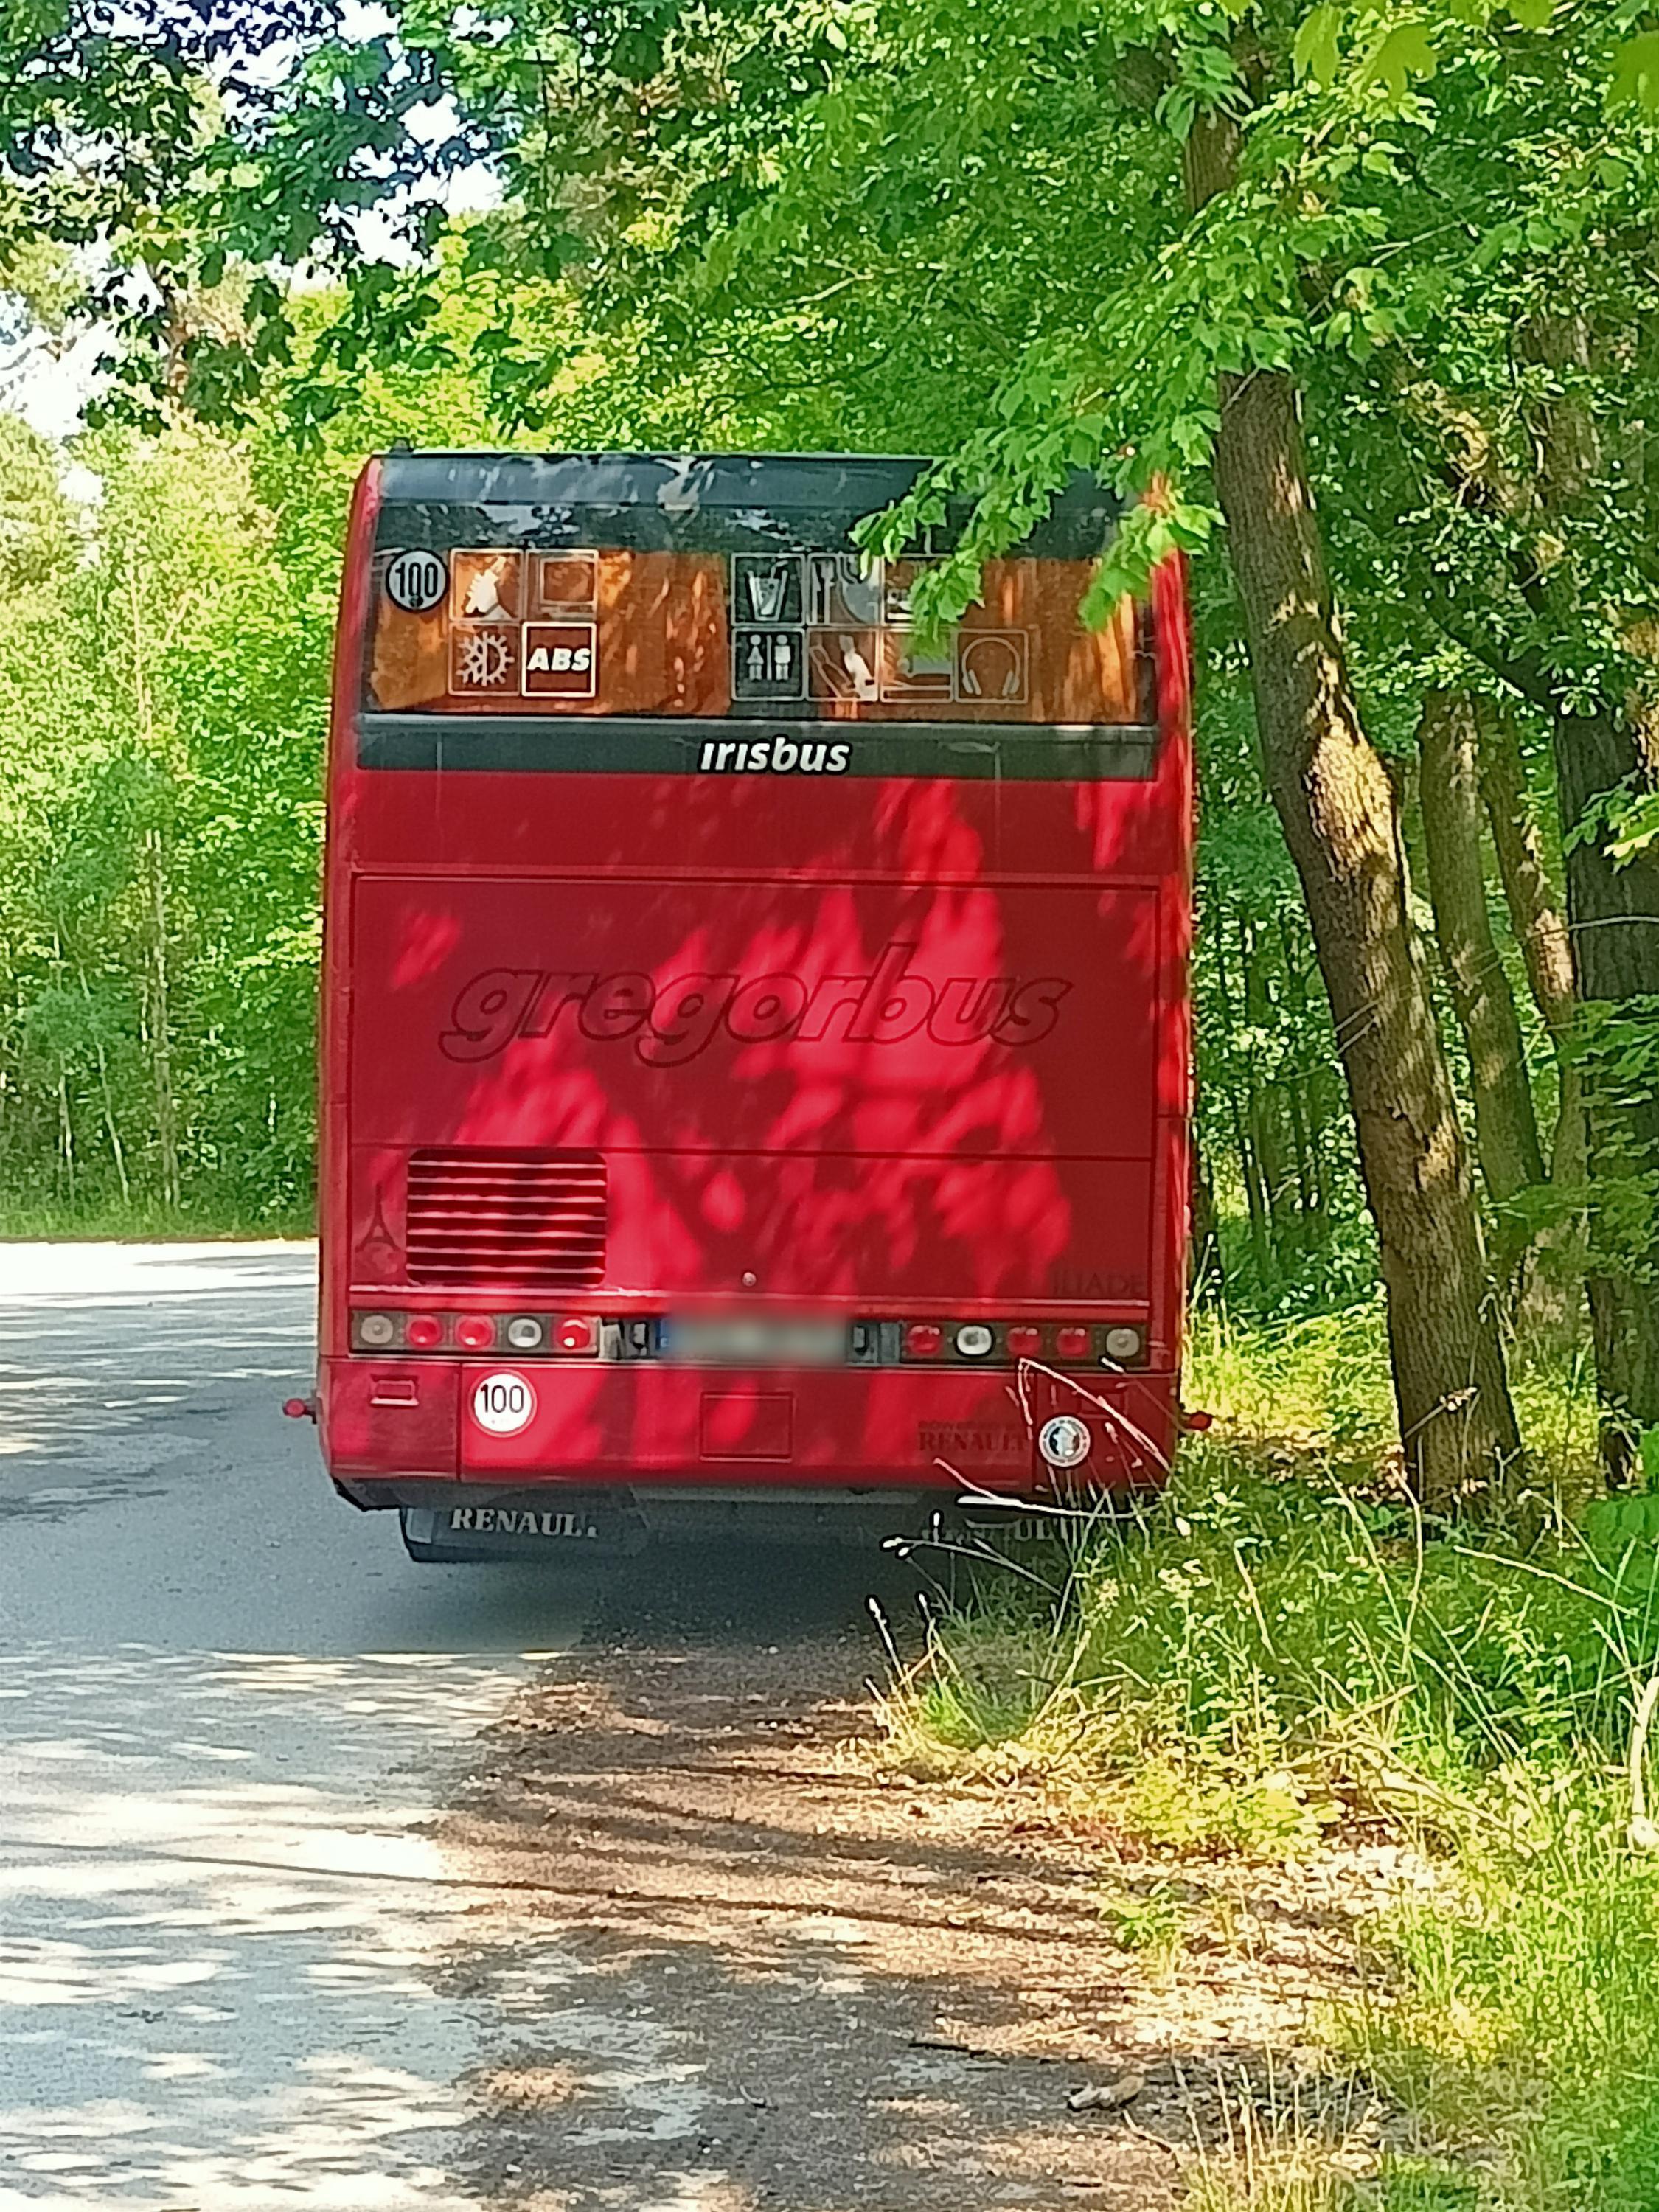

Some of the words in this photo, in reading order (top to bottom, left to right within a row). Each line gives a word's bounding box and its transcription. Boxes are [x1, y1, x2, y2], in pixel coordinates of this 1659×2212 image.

[394, 561, 439, 598] 100
[527, 647, 591, 672] ABS
[438, 942, 1074, 1068] gregorbus
[479, 1383, 526, 1414] 100
